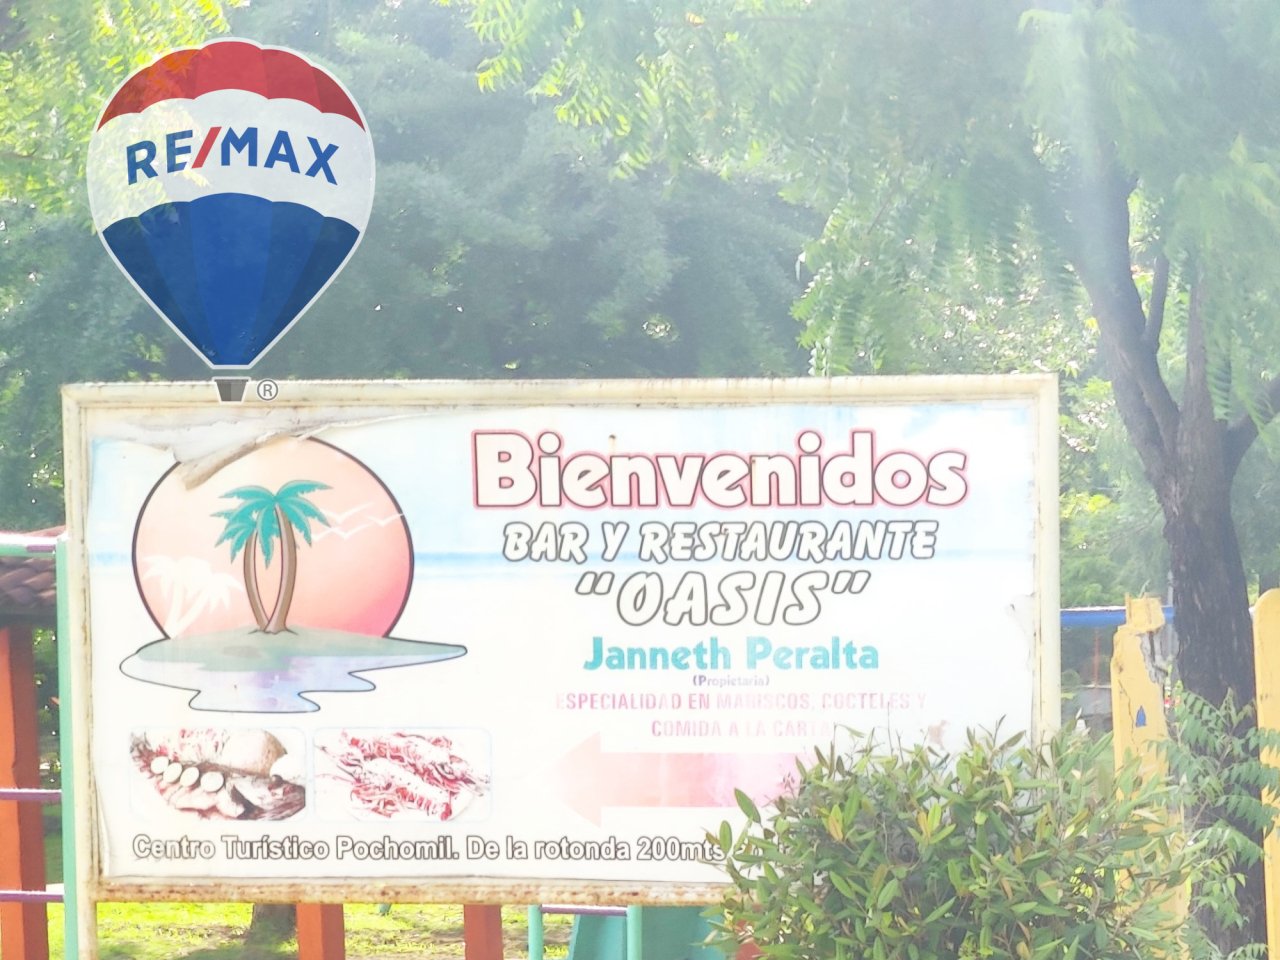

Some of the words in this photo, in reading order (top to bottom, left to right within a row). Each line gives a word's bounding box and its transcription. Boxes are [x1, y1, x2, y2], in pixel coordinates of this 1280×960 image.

[472, 429, 969, 511] Bienvenidos
[502, 520, 590, 564] BAR
[601, 521, 630, 563] Y
[639, 520, 940, 565] RESTAURANTE
[583, 636, 731, 670] Janneth
[746, 636, 880, 670] Peralta
[692, 674, 771, 688] (Propietaria)
[555, 692, 682, 710] ESPECIALIDAD
[688, 692, 711, 710] EN
[822, 692, 910, 710] COCTELES
[914, 692, 928, 710] Y
[651, 719, 722, 737] COMIDA
[728, 719, 740, 737] A
[744, 719, 768, 737] LA
[132, 834, 216, 861] Centro
[221, 834, 330, 860] Turístico
[335, 835, 460, 860] Pochomil.
[466, 835, 501, 860] De
[505, 836, 528, 860] la
[534, 836, 631, 861] rotonda
